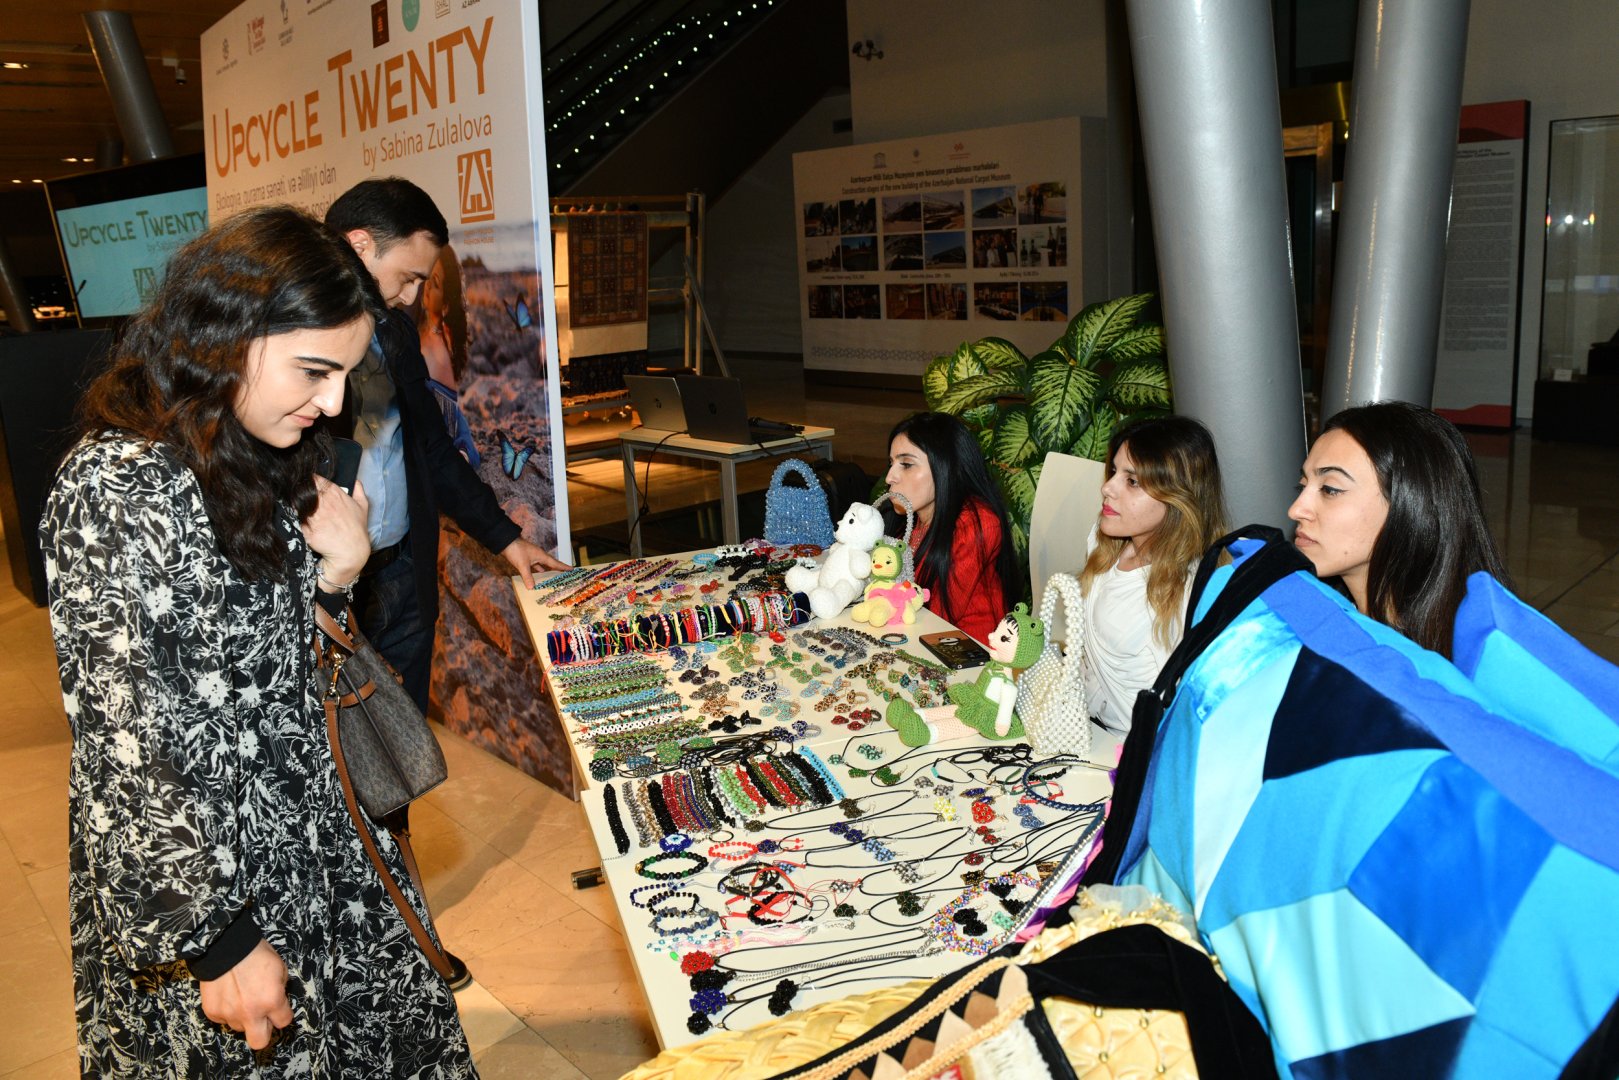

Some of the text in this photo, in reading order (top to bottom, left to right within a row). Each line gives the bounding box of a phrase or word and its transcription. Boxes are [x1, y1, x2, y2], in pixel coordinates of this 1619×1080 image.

[212, 16, 494, 178] UPCYCLE TWENTY
[362, 113, 493, 172] by Sabina Zulalova
[287, 176, 297, 193] və
[319, 162, 337, 186] olan
[64, 221, 136, 248] UPCYCLE
[136, 210, 207, 239] TWENTY
